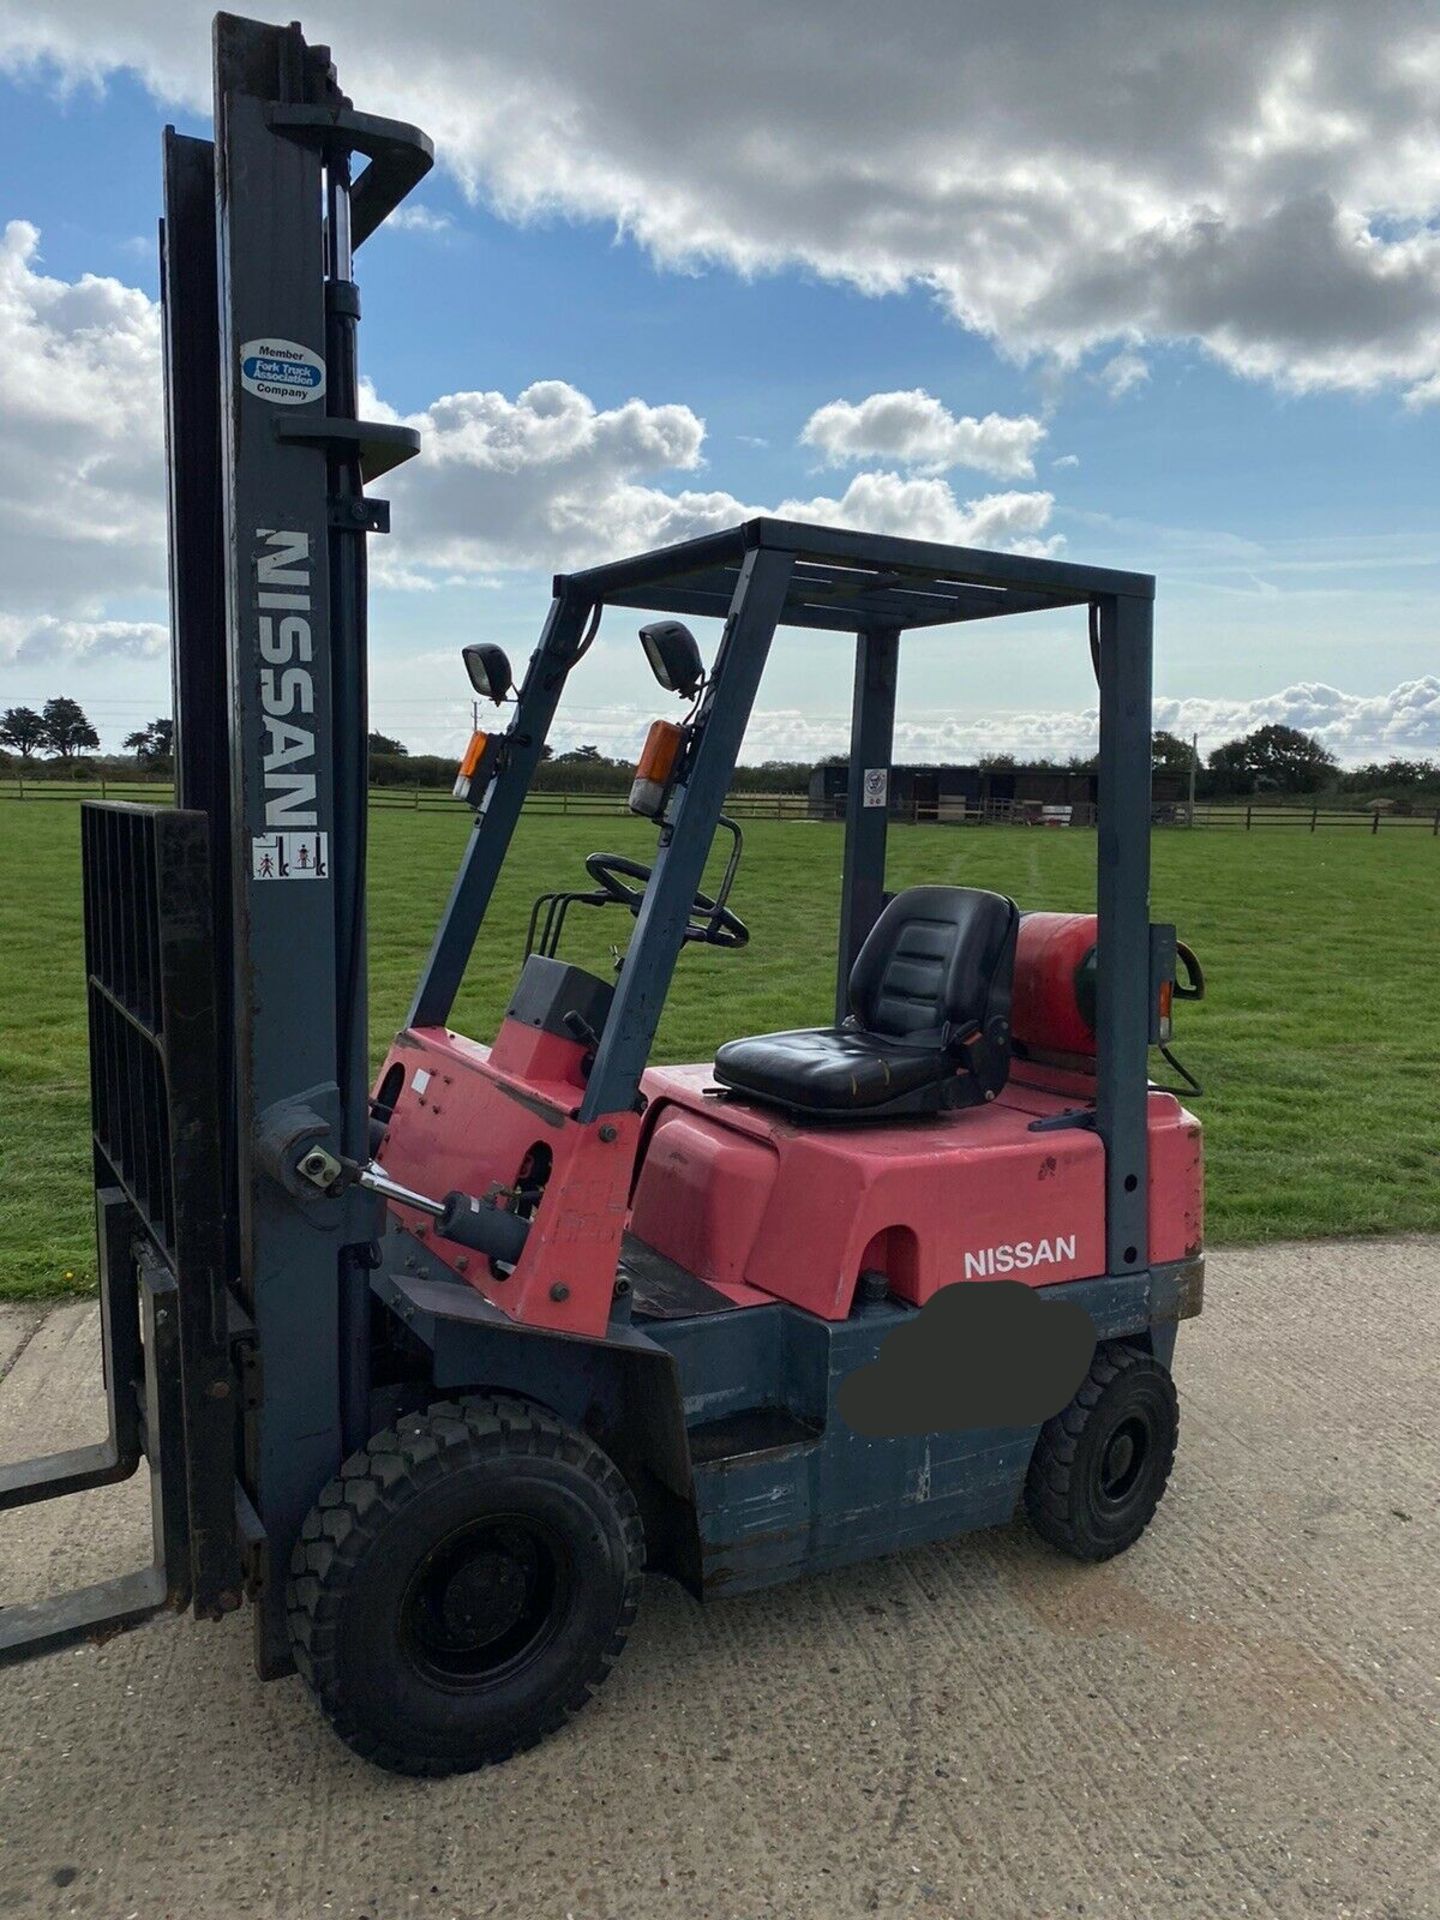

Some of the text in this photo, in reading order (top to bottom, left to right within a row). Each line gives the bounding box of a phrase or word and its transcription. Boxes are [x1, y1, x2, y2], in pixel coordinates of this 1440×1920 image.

[259, 346, 304, 361] Member
[256, 360, 311, 377] Fork Truck
[253, 371, 313, 386] Association
[257, 383, 308, 400] Company
[256, 528, 318, 827] NISSAN
[964, 1234, 1077, 1279] NISSAN
